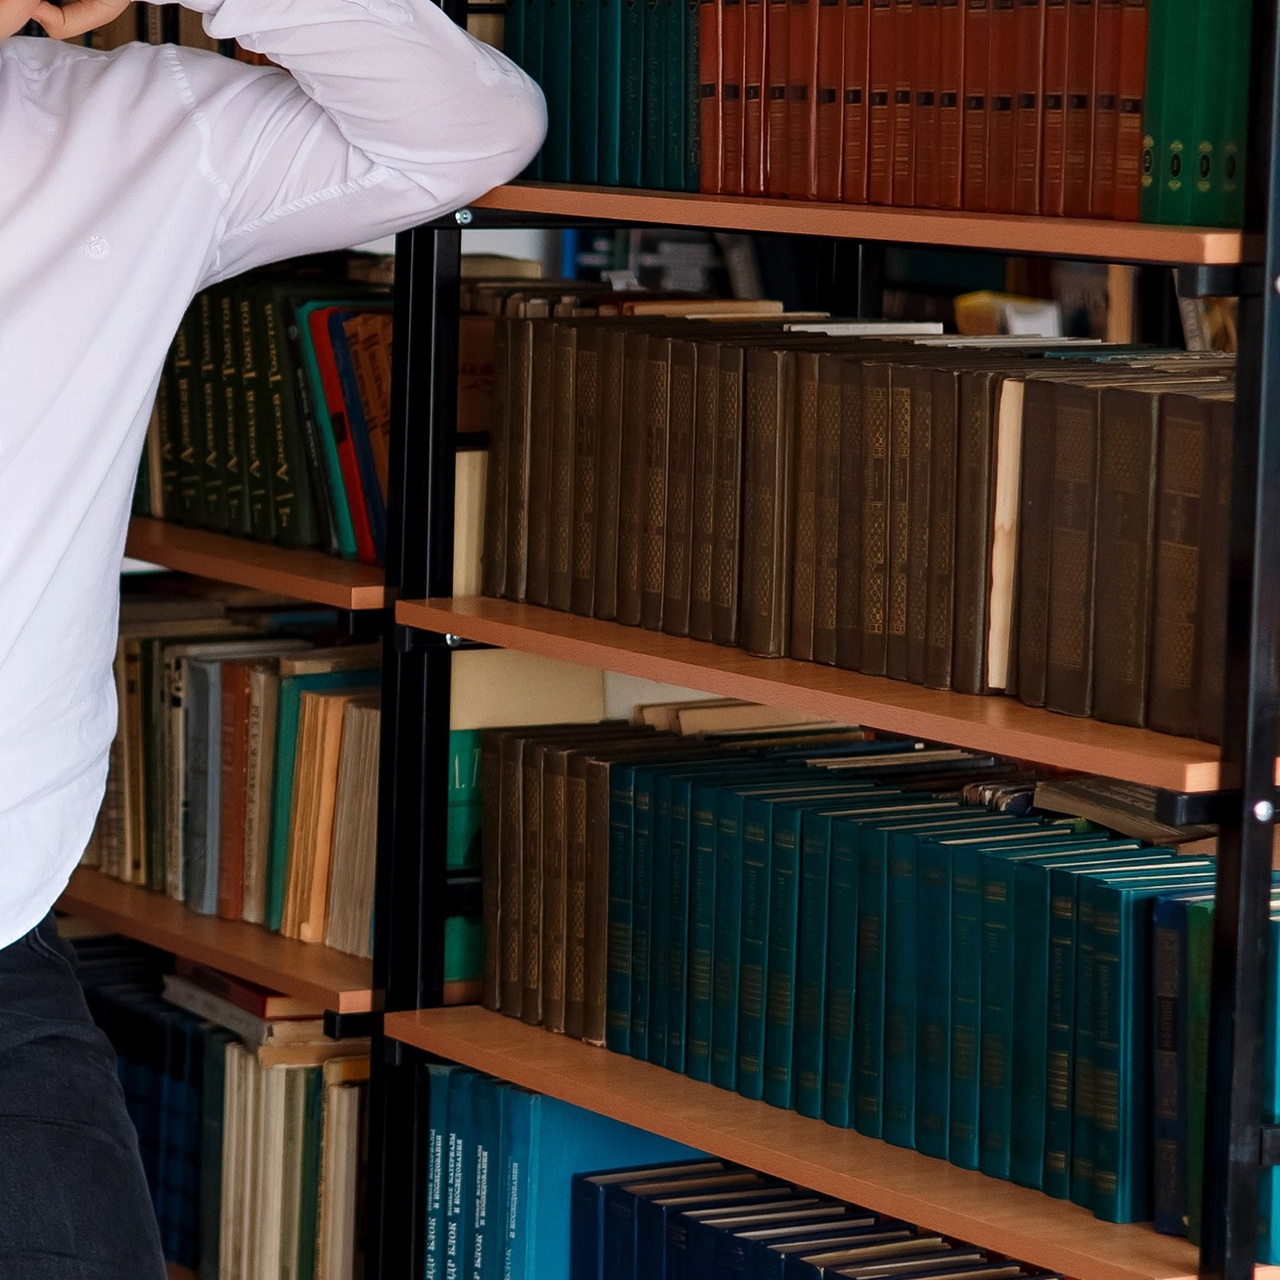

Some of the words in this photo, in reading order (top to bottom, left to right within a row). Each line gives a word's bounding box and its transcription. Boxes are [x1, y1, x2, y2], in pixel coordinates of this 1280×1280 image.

[425, 1217, 437, 1251] БЛОК
[446, 1221, 457, 1256] БЛОК
[472, 1233, 483, 1269] БЛОК
